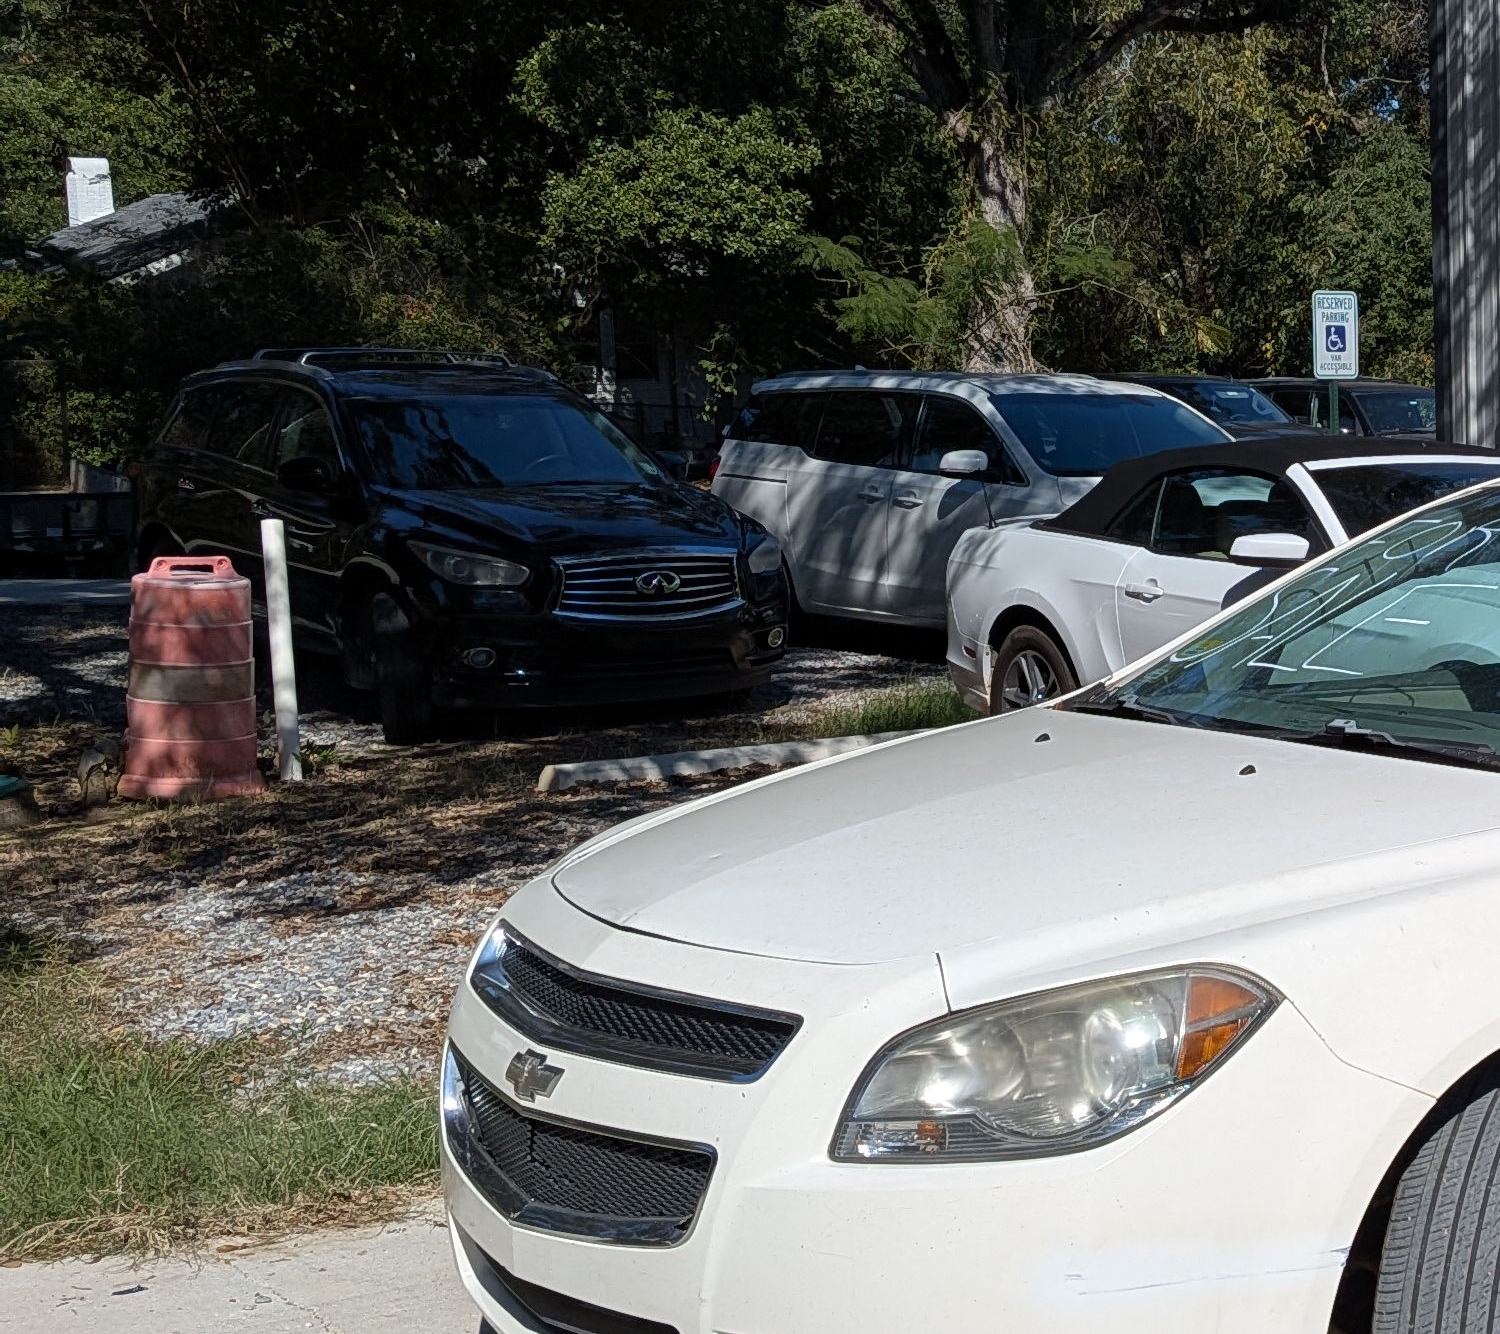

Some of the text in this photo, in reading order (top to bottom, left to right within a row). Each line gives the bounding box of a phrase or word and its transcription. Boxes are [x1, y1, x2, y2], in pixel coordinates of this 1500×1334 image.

[1317, 297, 1352, 310] RESERVED
[1321, 311, 1349, 323] PARKING
[1331, 354, 1342, 362] VAN
[1319, 363, 1353, 371] ACCESSIBLE
[1169, 567, 1499, 676] SALE
